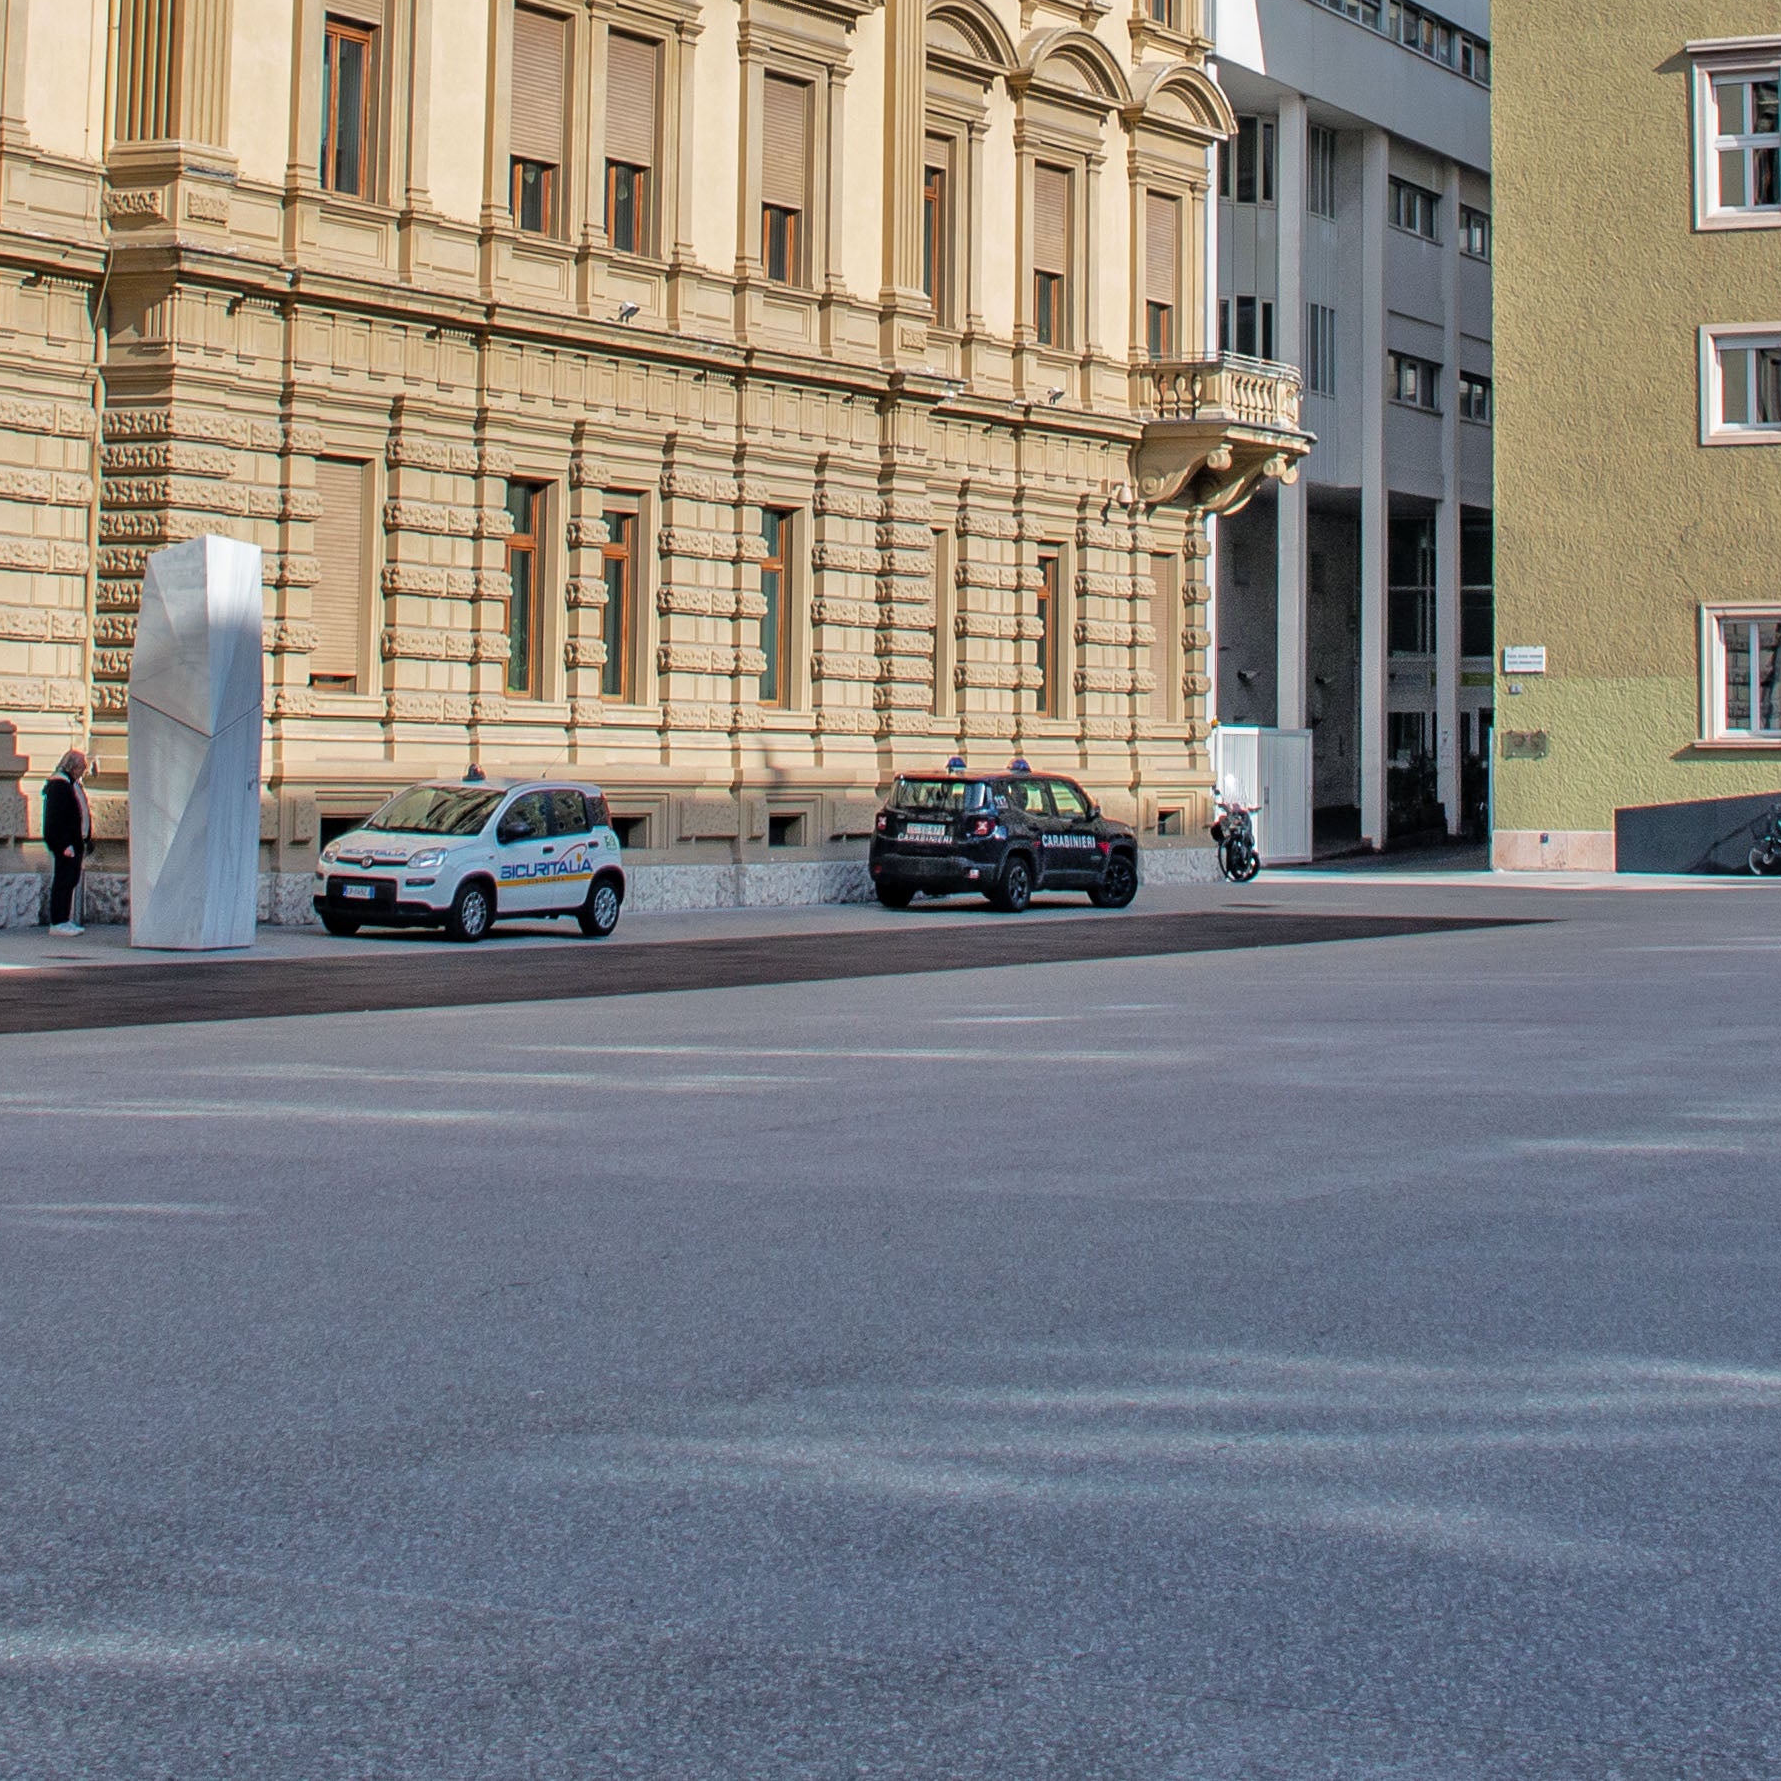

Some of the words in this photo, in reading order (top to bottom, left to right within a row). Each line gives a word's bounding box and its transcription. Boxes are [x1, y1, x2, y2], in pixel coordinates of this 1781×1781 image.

[898, 832, 953, 844] CARABINIERI
[1041, 834, 1096, 848] CARABINIERI
[501, 858, 593, 879] SICURITALIA
